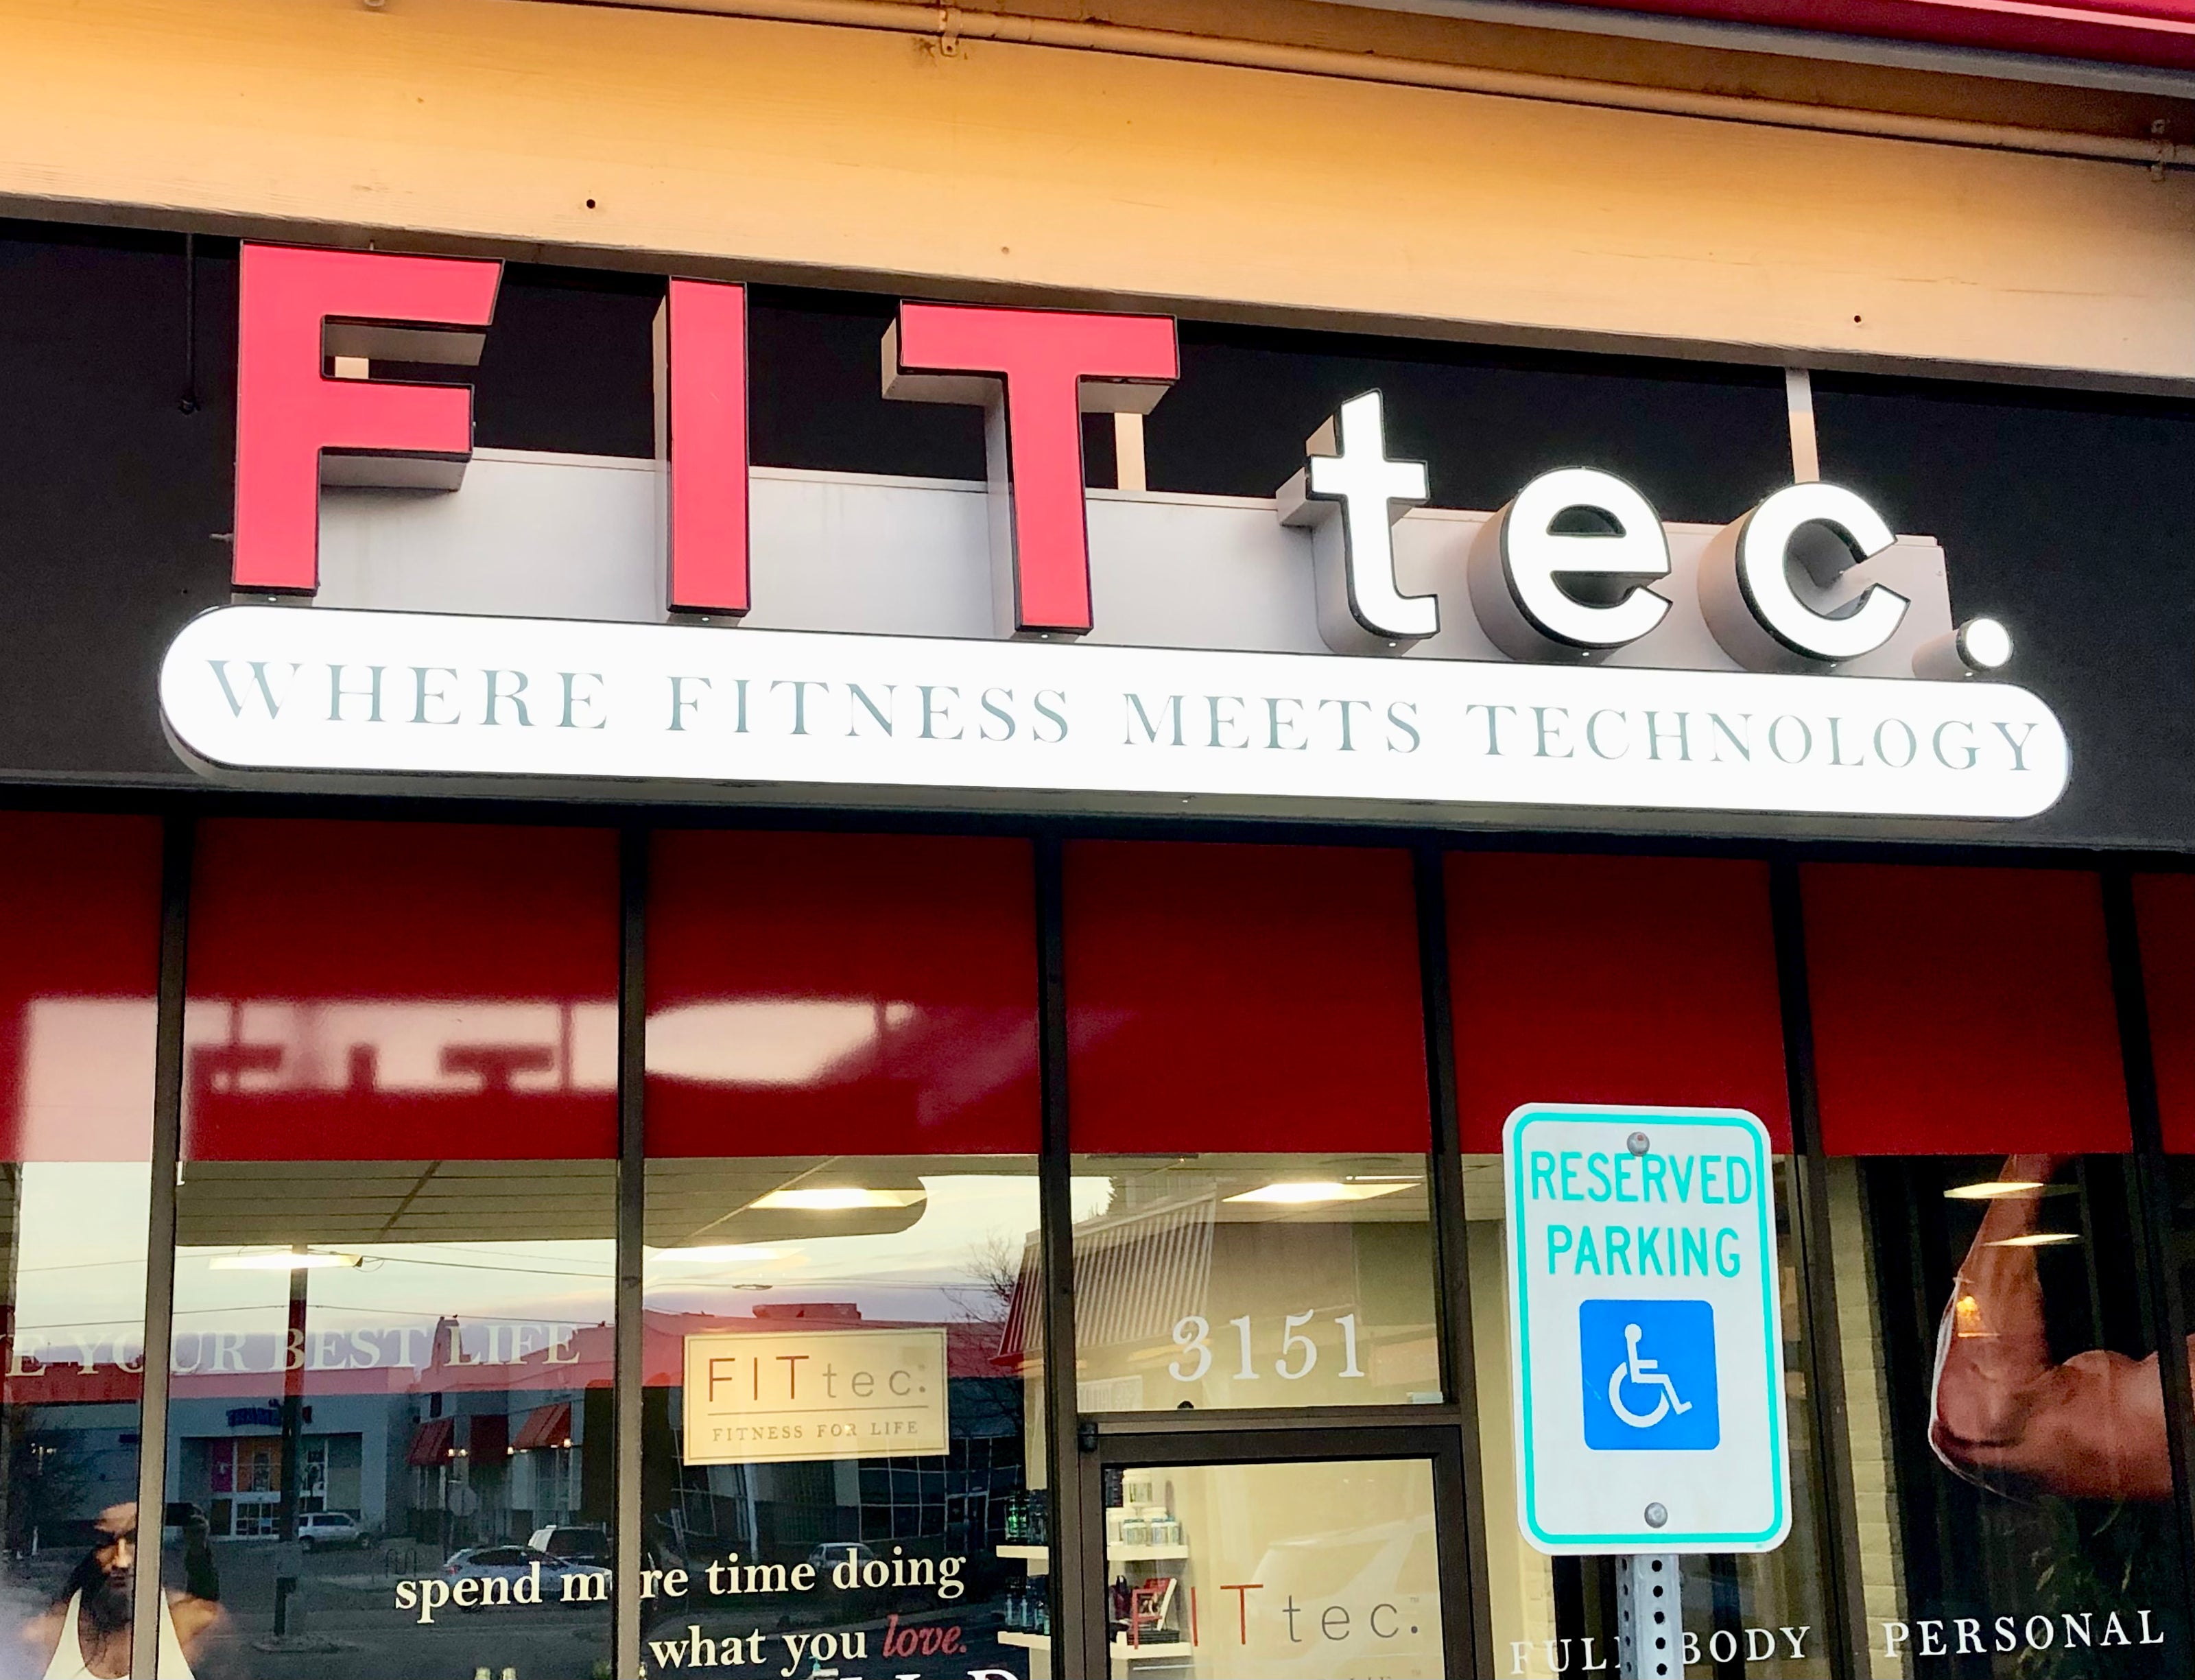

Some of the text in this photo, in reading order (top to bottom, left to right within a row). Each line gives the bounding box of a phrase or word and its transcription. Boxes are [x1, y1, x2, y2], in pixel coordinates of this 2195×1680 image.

[206, 659, 2039, 772] WHERE FITNESS MEETS TECHNOLOGY
[1531, 1151, 1752, 1205] RESERVED
[1547, 1224, 1741, 1278] PARKING
[268, 1325, 429, 1371] BEST
[443, 1323, 580, 1366] LIFE
[1168, 1308, 1365, 1382] 3151
[713, 1421, 918, 1442] FITNESS FOR LIFE
[395, 1546, 966, 1624] spend mre time doing
[648, 1613, 967, 1678] what you love.
[1510, 1609, 2165, 1675] FUL BODY PERSONAL
